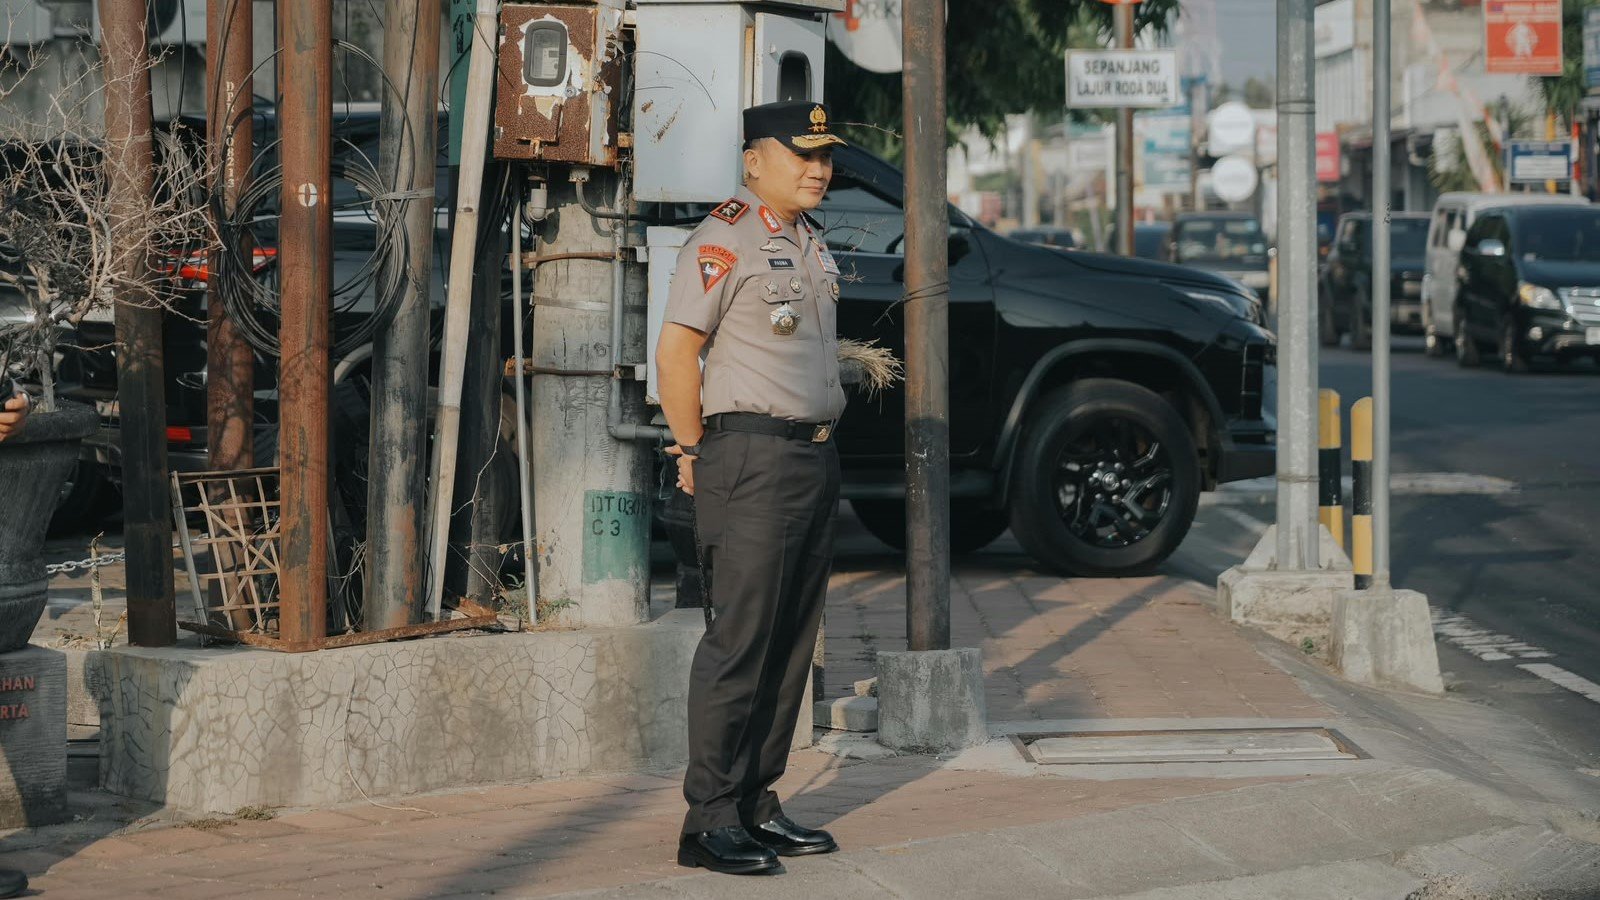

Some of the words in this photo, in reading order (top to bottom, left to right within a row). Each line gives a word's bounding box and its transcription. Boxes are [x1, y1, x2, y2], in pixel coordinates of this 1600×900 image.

[1084, 61, 1160, 75] SEPANJANG
[1077, 81, 1112, 96] LAJUR
[1115, 81, 1144, 96] RODA
[1147, 80, 1168, 96] DUA
